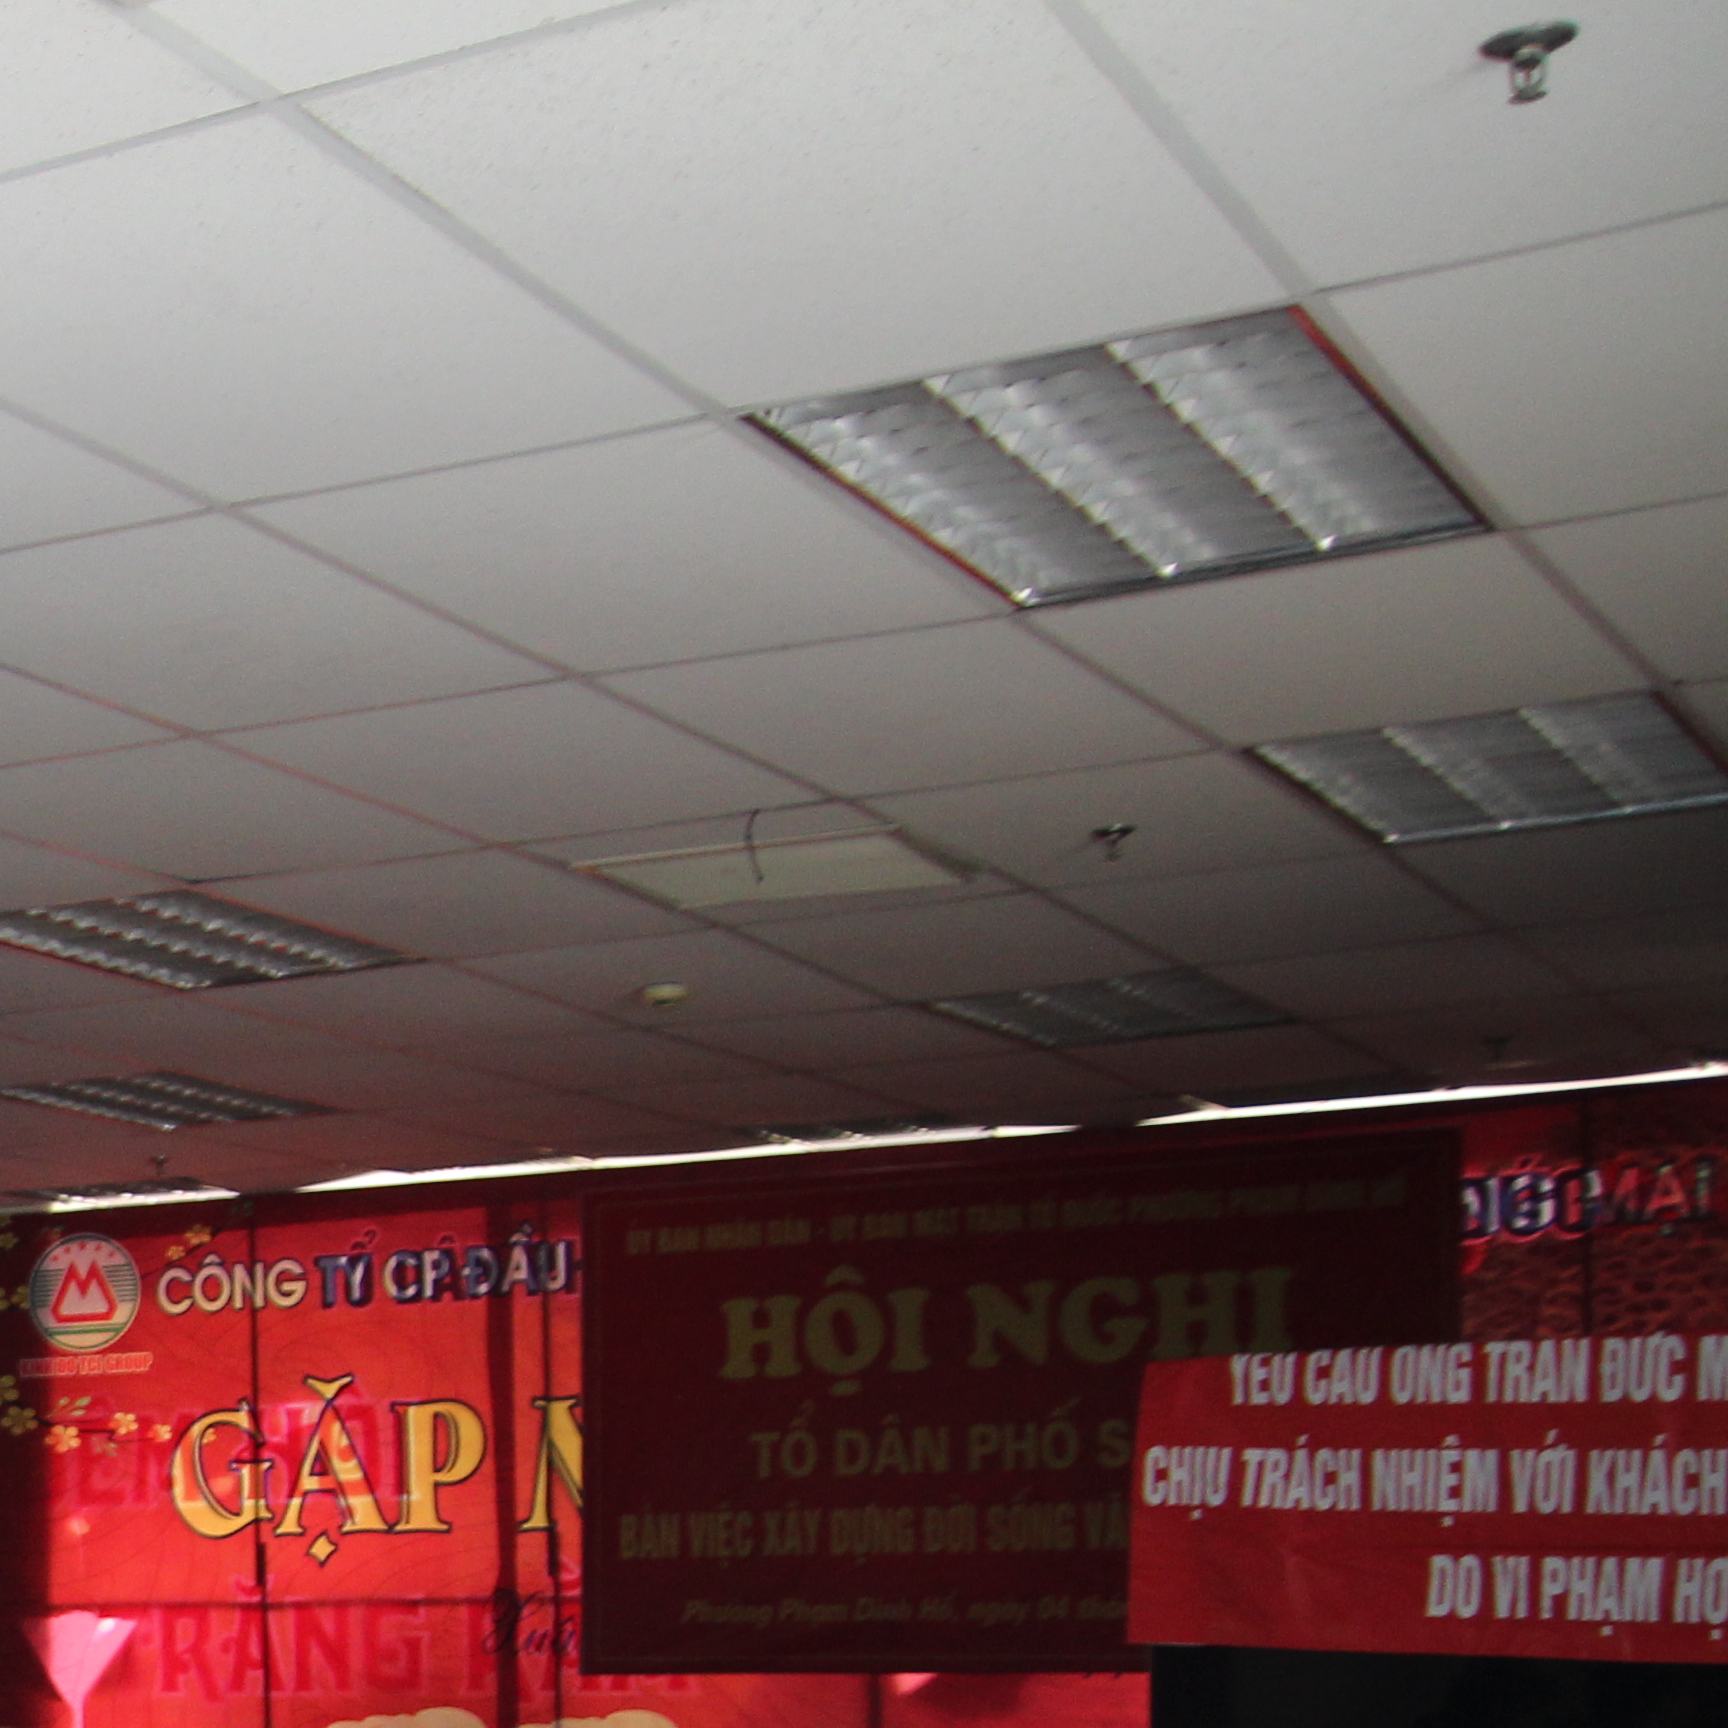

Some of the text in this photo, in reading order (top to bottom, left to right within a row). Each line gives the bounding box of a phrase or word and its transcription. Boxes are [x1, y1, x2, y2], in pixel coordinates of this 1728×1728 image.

[156, 1251, 308, 1316] CÔNG
[718, 1263, 933, 1398] HỘI
[169, 1374, 486, 1564] GẶP
[748, 1397, 1134, 1481] TỔ DÂN PHỐ S
[1143, 1428, 1728, 1528] CHỊU TRÁCH NHIỆM VỚI KHÁCH
[686, 1500, 757, 1569] VIỆC
[760, 1498, 823, 1559] XÂY
[984, 1486, 1078, 1555] SỐNG
[1081, 1491, 1130, 1554] VĂ
[1424, 1552, 1483, 1620] DO
[1489, 1553, 1531, 1621] VI
[1537, 1554, 1665, 1639] PHẠM
